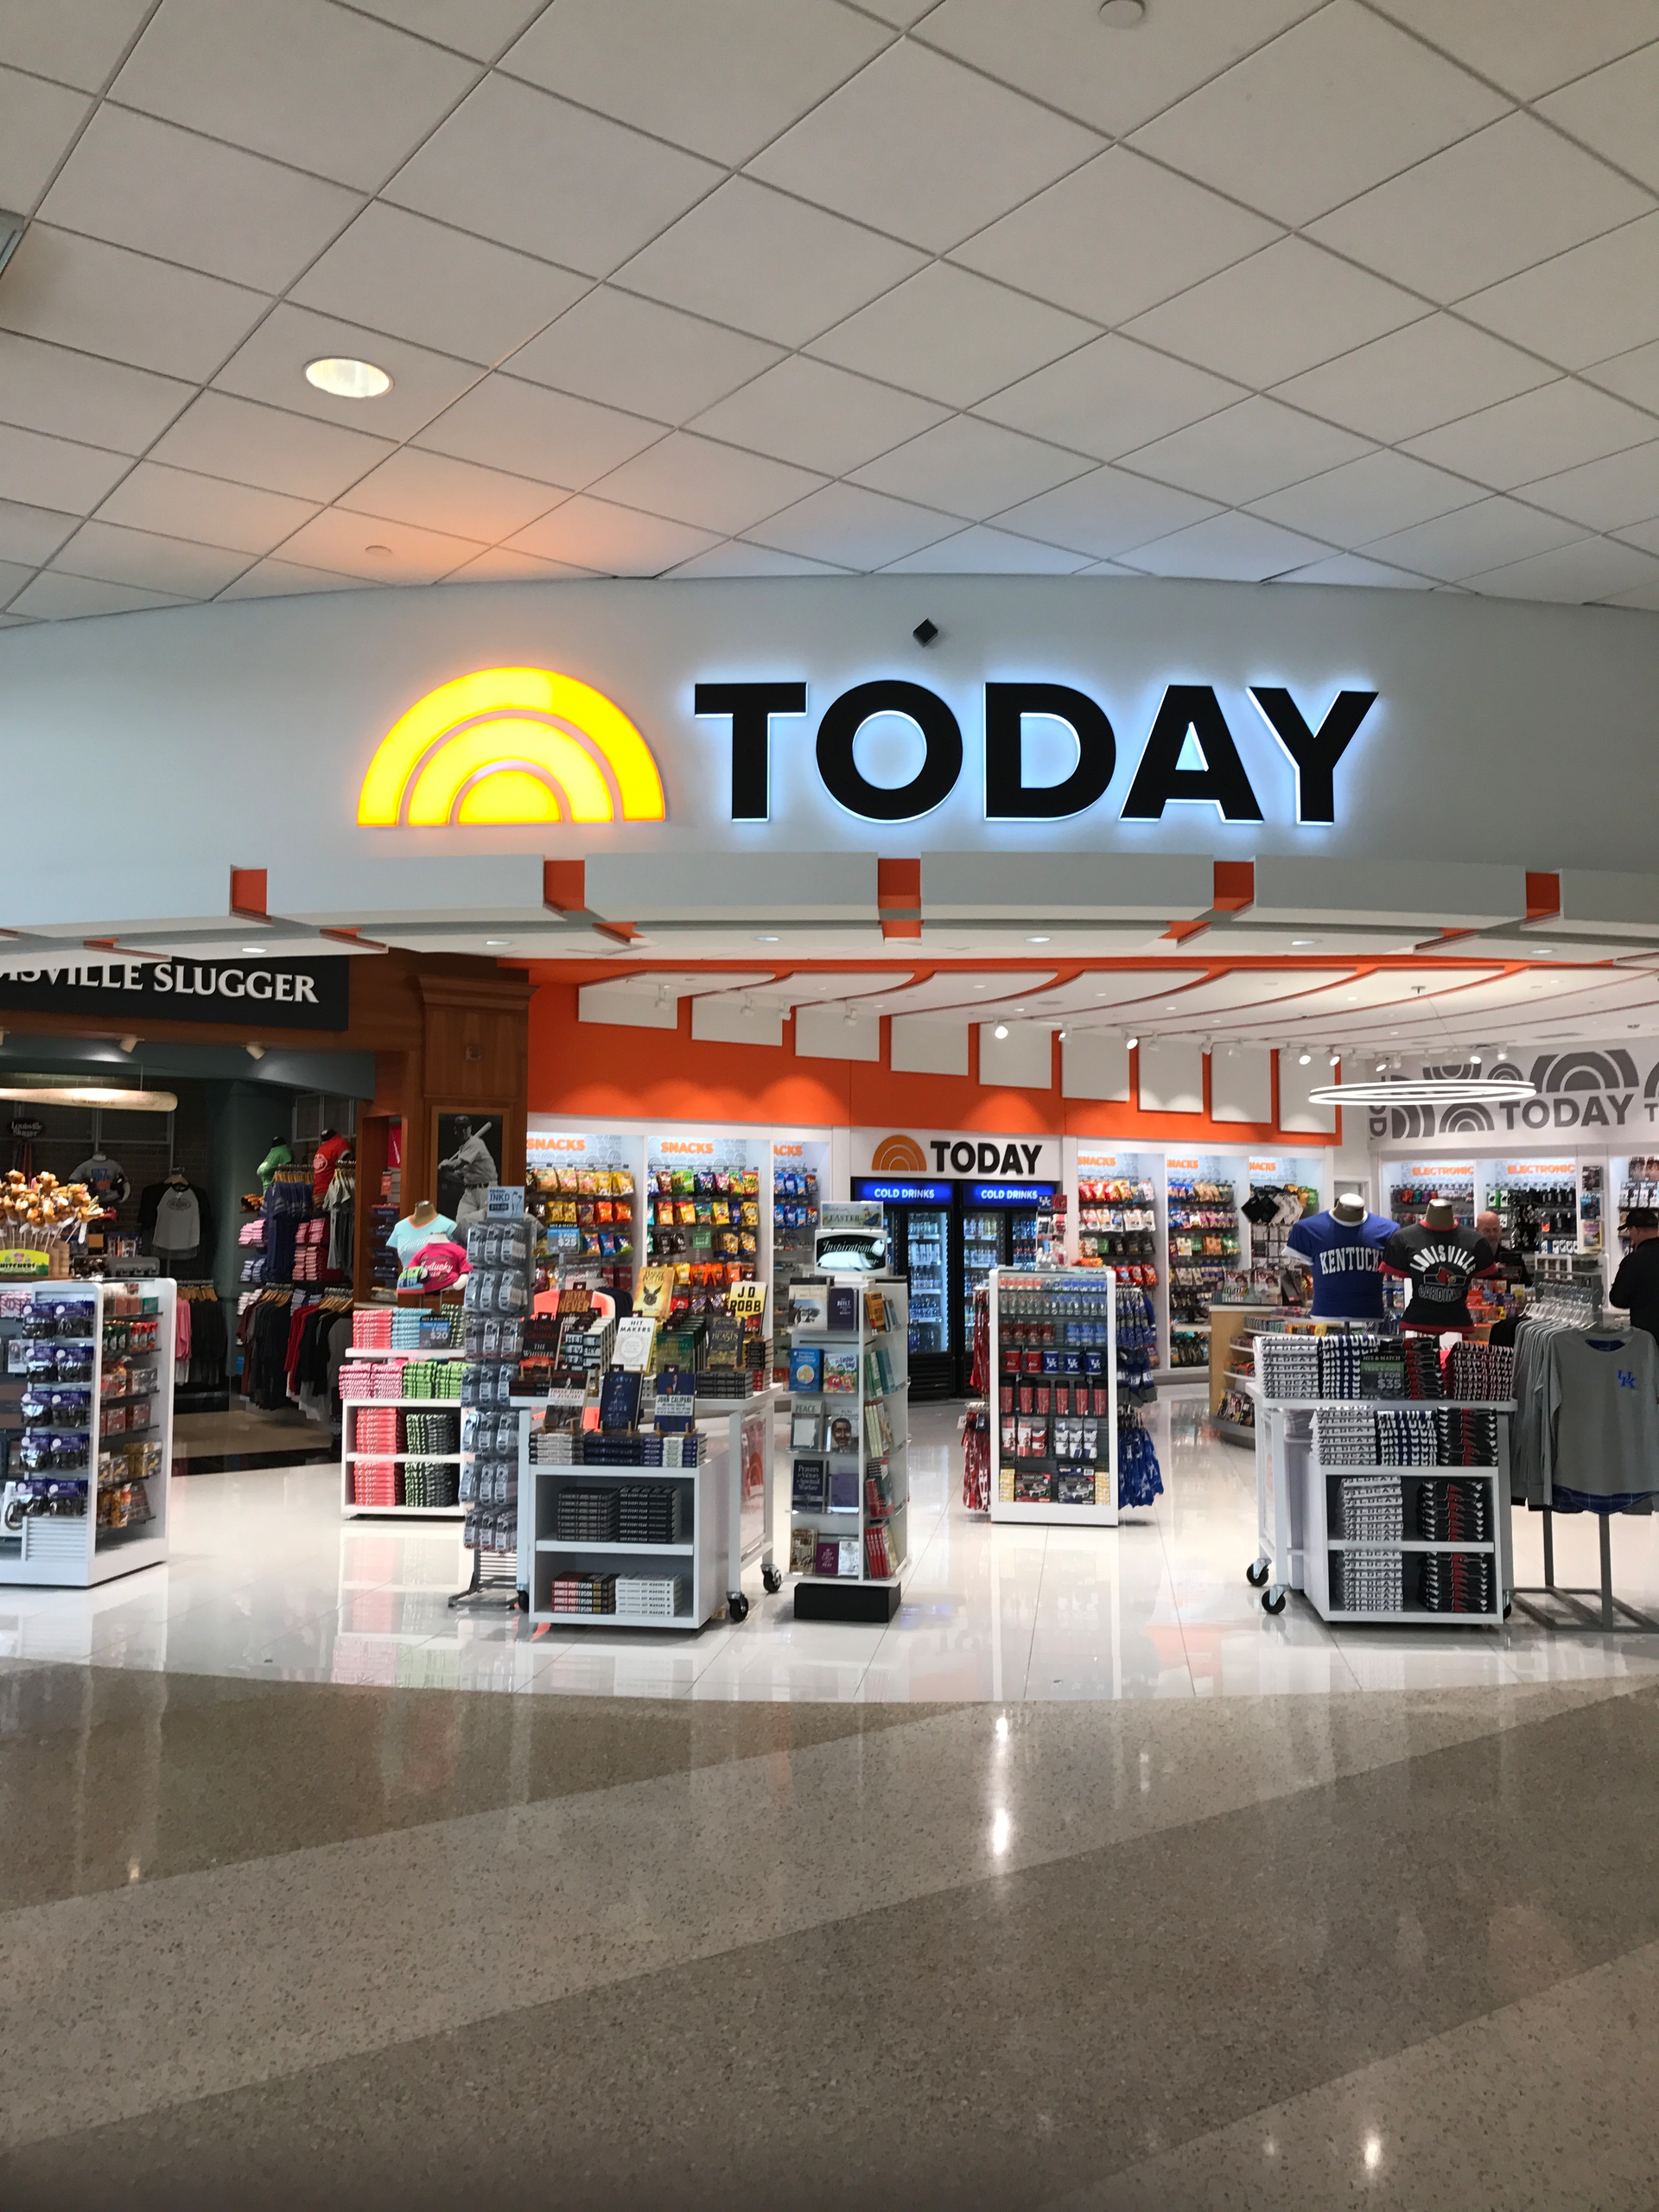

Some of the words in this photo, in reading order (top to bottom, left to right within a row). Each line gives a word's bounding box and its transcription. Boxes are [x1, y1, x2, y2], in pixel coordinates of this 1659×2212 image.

[694, 680, 1380, 825] TODAY
[153, 963, 320, 1003] SLUGGER
[1499, 1093, 1635, 1129] TODAY
[527, 1138, 586, 1151] SNACKS
[661, 1141, 714, 1154] SNACKS
[931, 1141, 1042, 1175] TODAY
[874, 1189, 899, 1198] COLD
[901, 1189, 935, 1199] DRINKS
[981, 1190, 1005, 1199] COLD
[1007, 1190, 1038, 1200] DRINKS
[830, 1214, 861, 1223] EASTER
[558, 1238, 577, 1247] $25
[1410, 1244, 1476, 1274] LOUISVILLE
[565, 1290, 587, 1299] NEVER
[559, 1300, 590, 1313] NEVER
[730, 1300, 761, 1313] ROBB
[430, 1332, 448, 1340] $20
[523, 1349, 554, 1359] WHISTLER
[1377, 1379, 1402, 1389] $35
[795, 1404, 816, 1413] PEACE
[798, 1465, 819, 1473] Prayers
